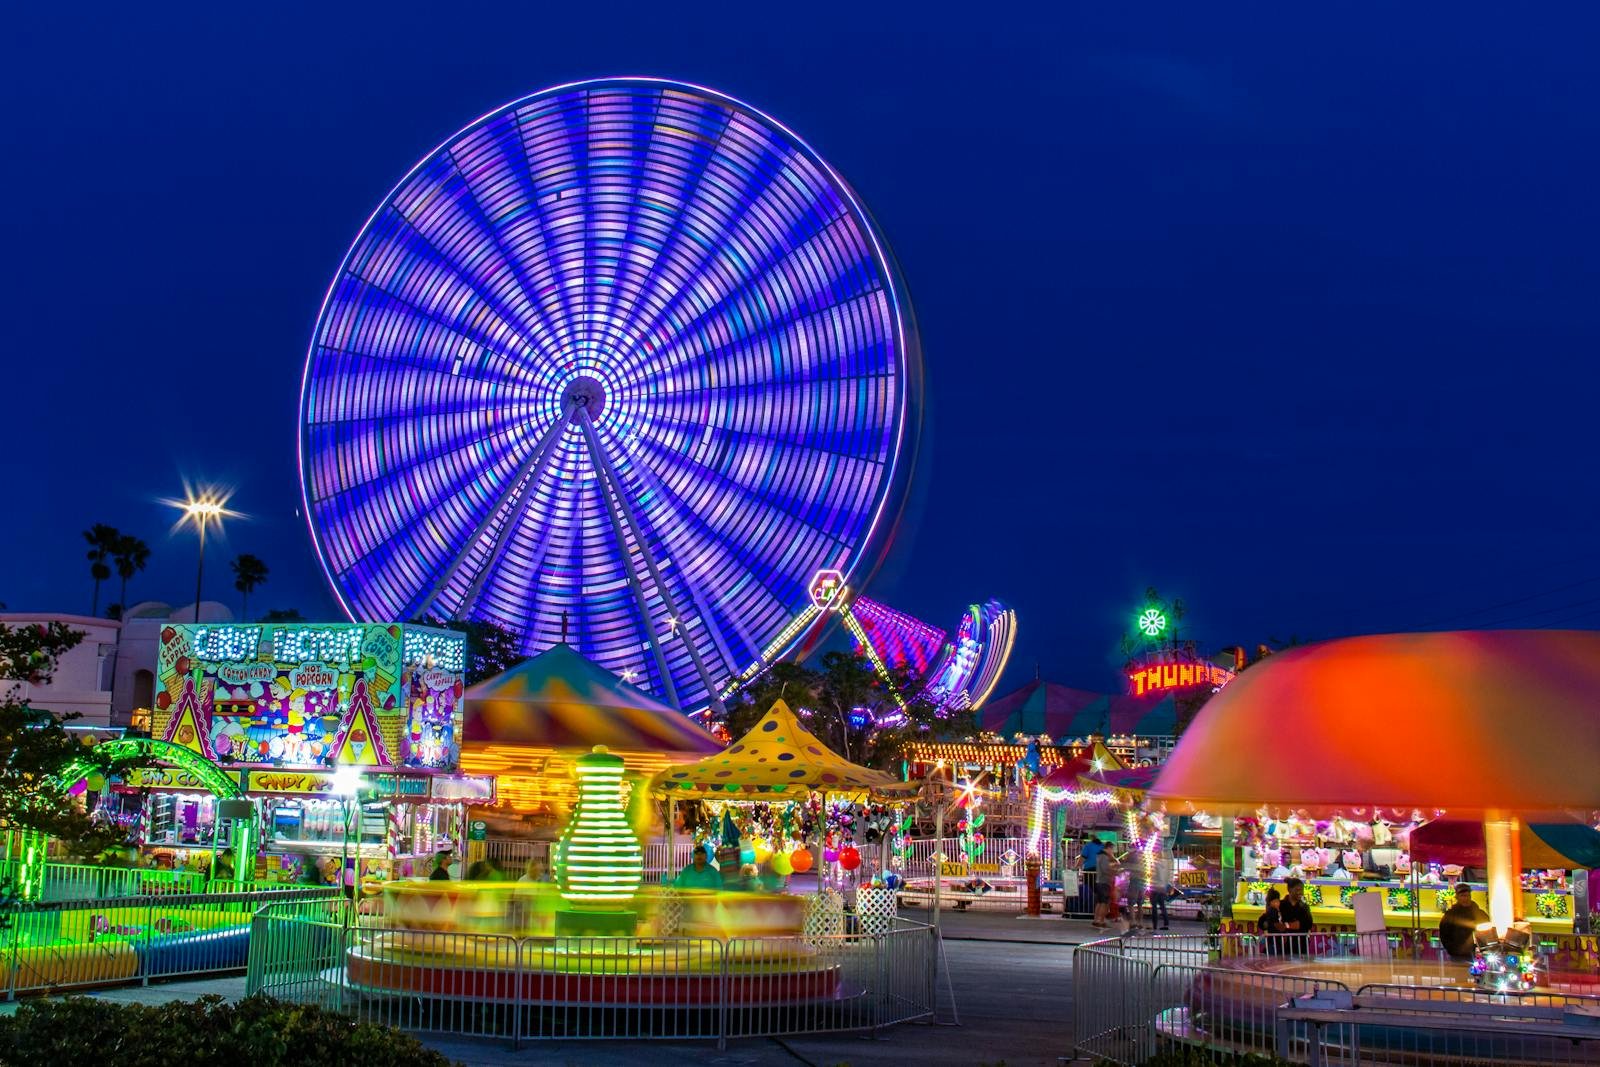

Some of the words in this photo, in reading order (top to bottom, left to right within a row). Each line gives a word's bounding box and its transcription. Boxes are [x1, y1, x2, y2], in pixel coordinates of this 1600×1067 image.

[162, 633, 184, 658] CANDY
[194, 626, 262, 661] CANDY
[273, 627, 364, 662] FACTORY
[165, 642, 190, 667] APPLES
[223, 667, 248, 680] COTTON
[250, 667, 272, 679] CANDY
[304, 665, 321, 673] HOT
[296, 673, 333, 686] POPCORN
[141, 770, 172, 786] SNO
[256, 774, 306, 790] CANDY
[941, 863, 964, 876] EXIT
[1180, 871, 1206, 884] ENTER
